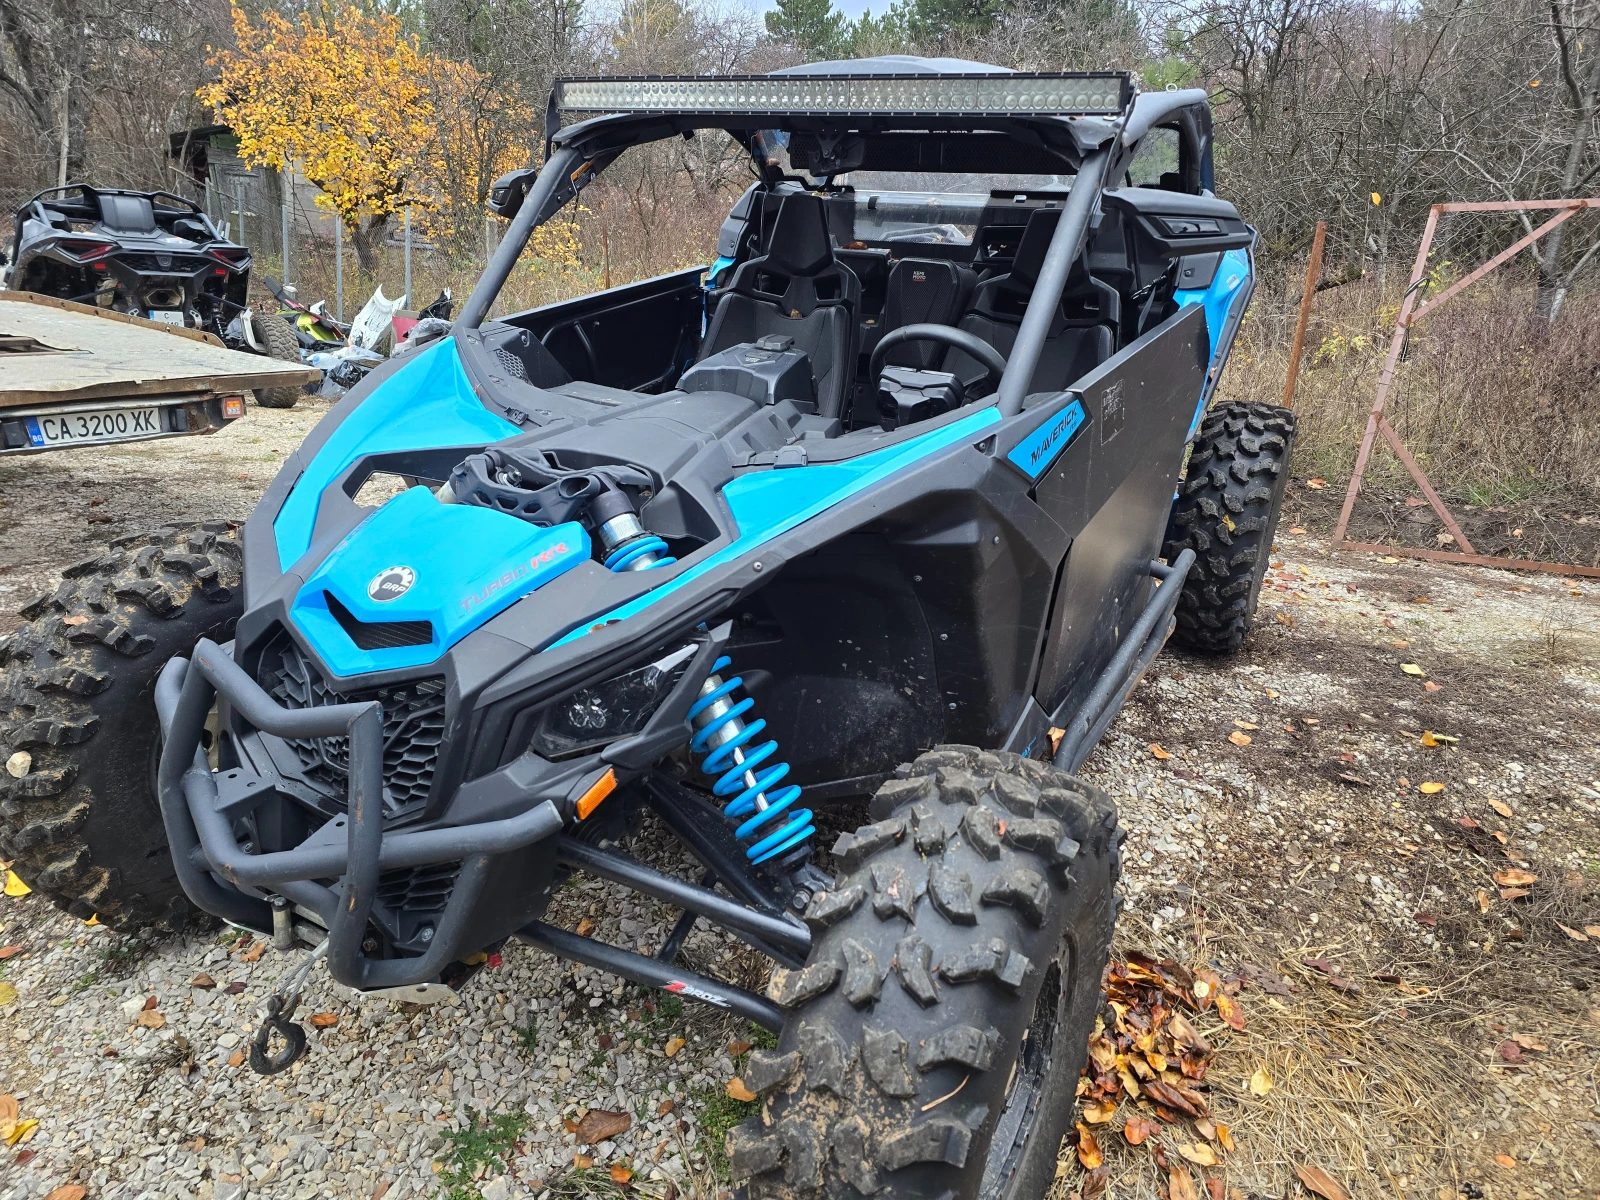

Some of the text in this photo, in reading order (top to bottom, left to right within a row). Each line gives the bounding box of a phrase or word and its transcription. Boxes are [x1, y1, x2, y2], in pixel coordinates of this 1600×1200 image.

[43, 410, 156, 440] CA 3200 XK
[1030, 404, 1077, 466] MAVERICK
[382, 582, 406, 592] BRP
[460, 542, 569, 611] TURBO RR
